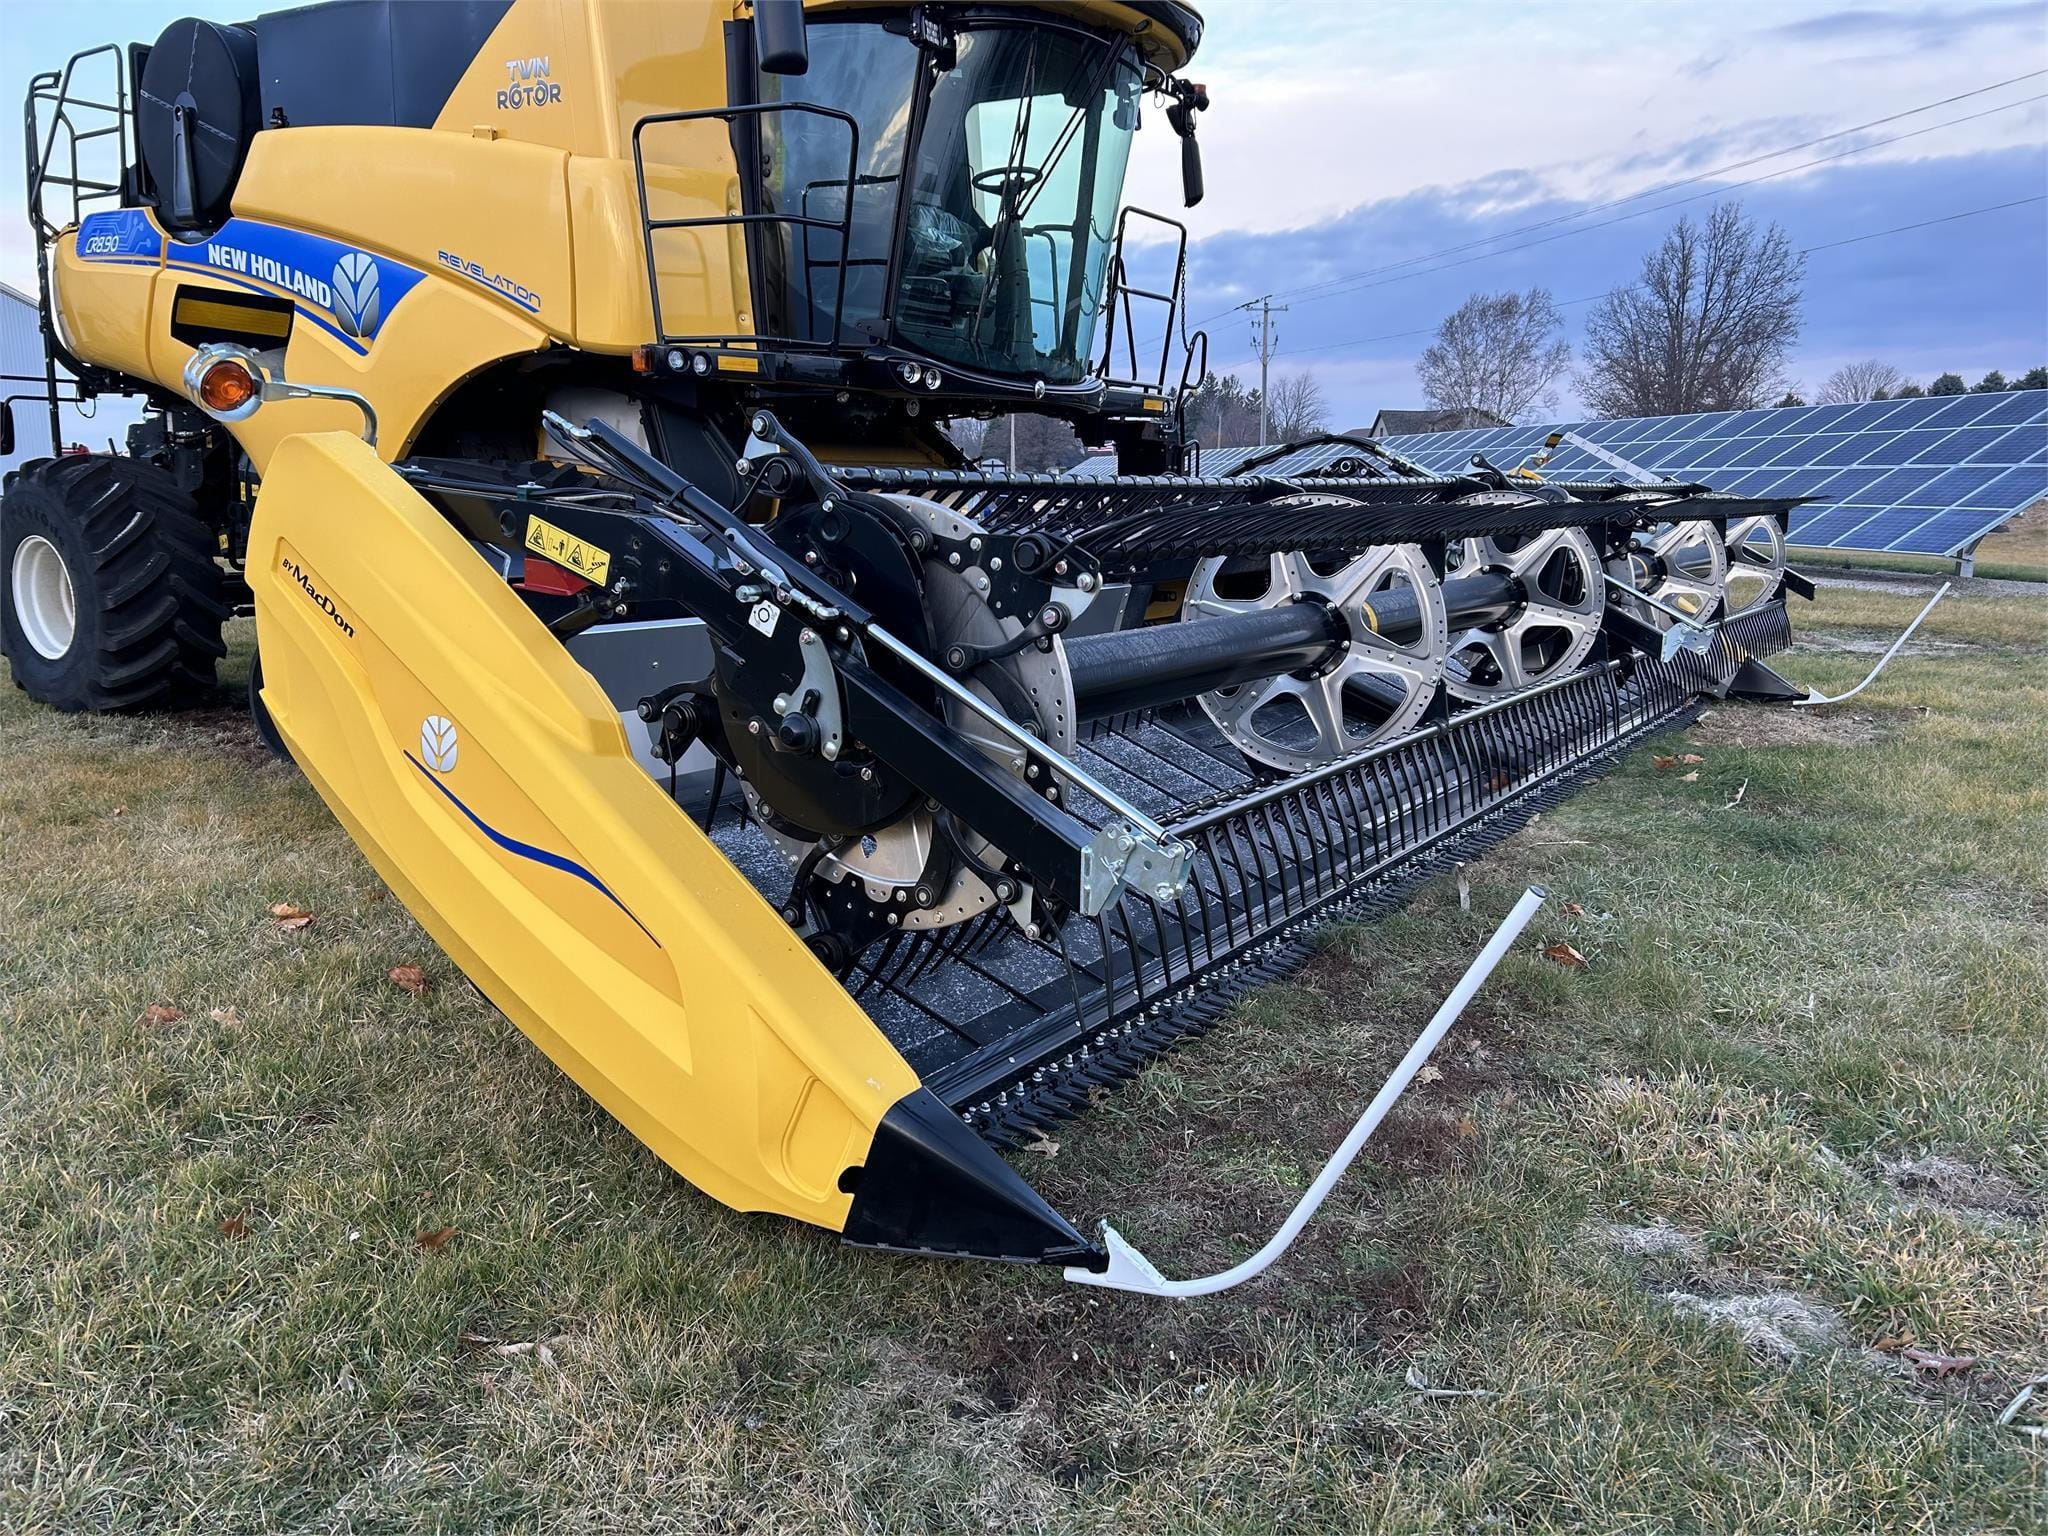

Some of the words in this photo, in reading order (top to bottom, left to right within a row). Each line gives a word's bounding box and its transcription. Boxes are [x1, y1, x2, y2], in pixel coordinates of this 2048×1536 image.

[496, 79, 562, 110] ROTOR
[505, 55, 550, 81] TWIN
[207, 243, 247, 273] NEW
[250, 253, 332, 309] HOLLAND
[438, 250, 541, 308] REVELATION
[282, 557, 294, 572] BY
[292, 564, 355, 639] MacDon
